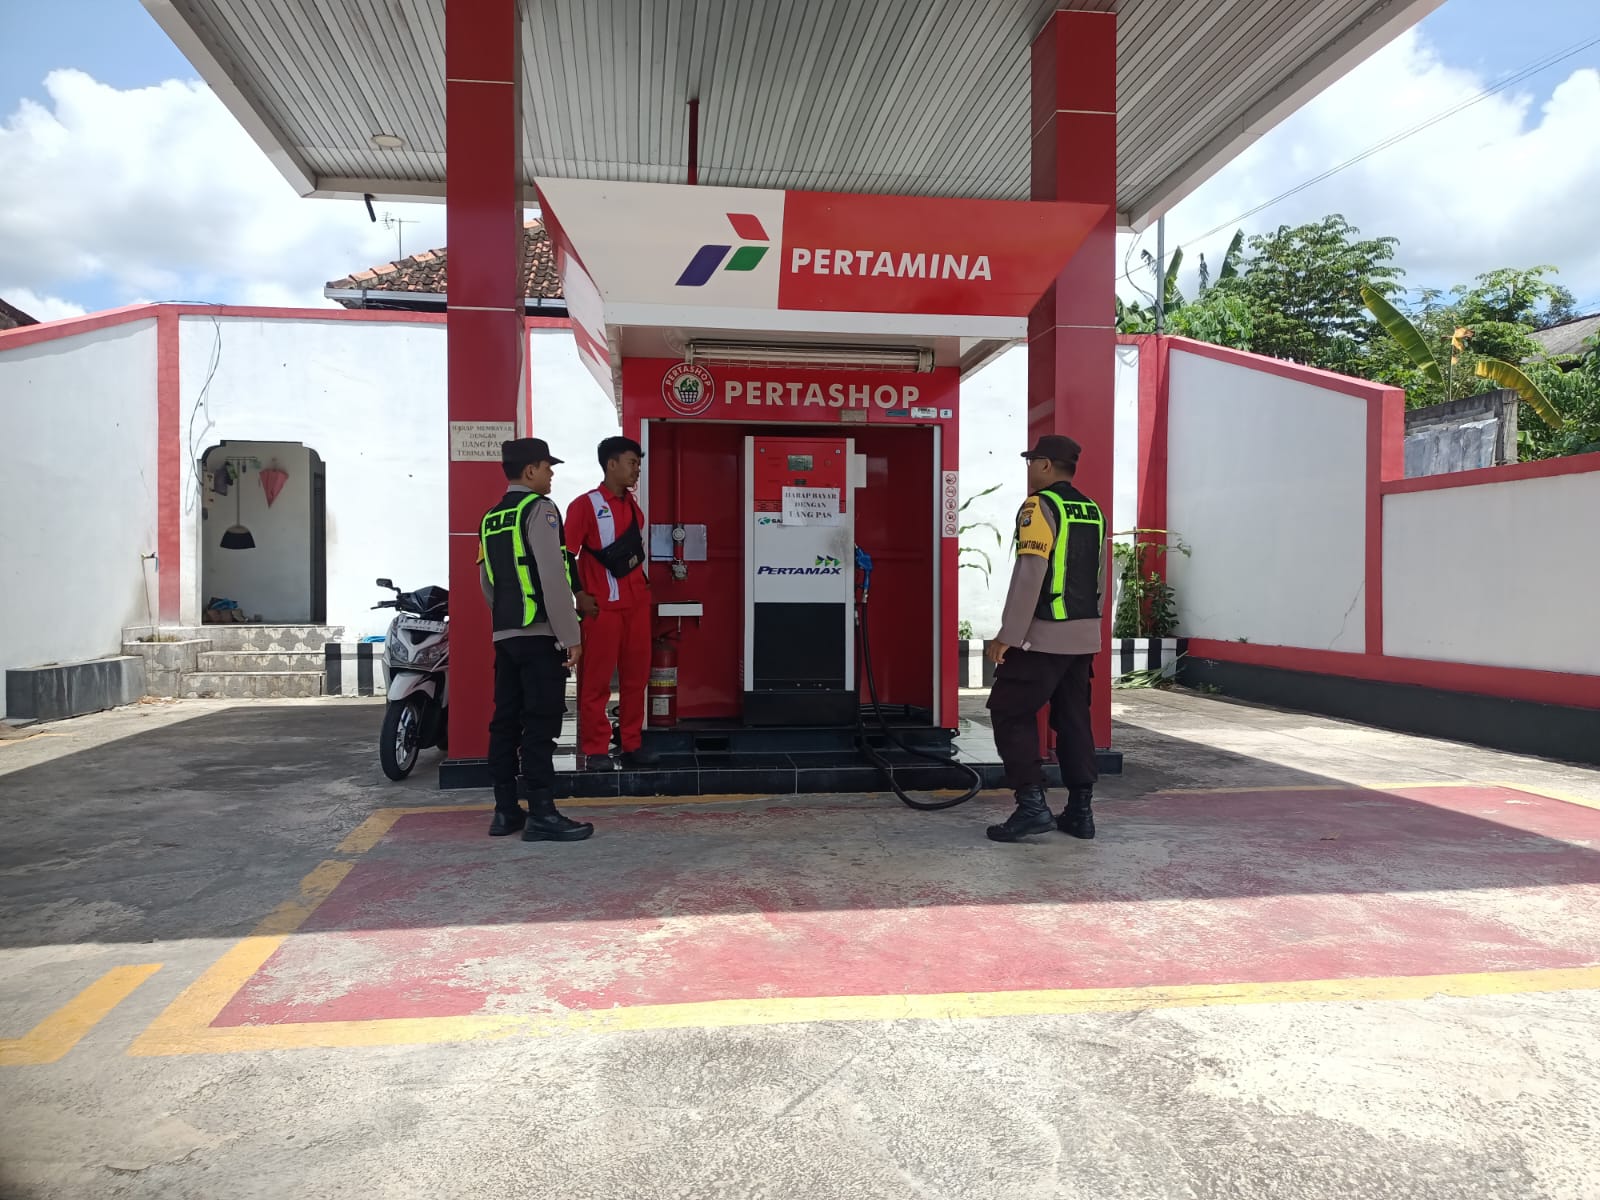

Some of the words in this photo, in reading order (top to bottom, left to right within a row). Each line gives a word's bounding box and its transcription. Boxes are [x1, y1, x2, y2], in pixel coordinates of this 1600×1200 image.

[791, 247, 992, 281] PERTAMINA
[665, 365, 711, 386] PERTASHOP
[724, 380, 920, 409] PERTASHOP
[462, 440, 486, 448] UANG
[789, 510, 814, 518] UANG
[815, 511, 832, 519] PAS
